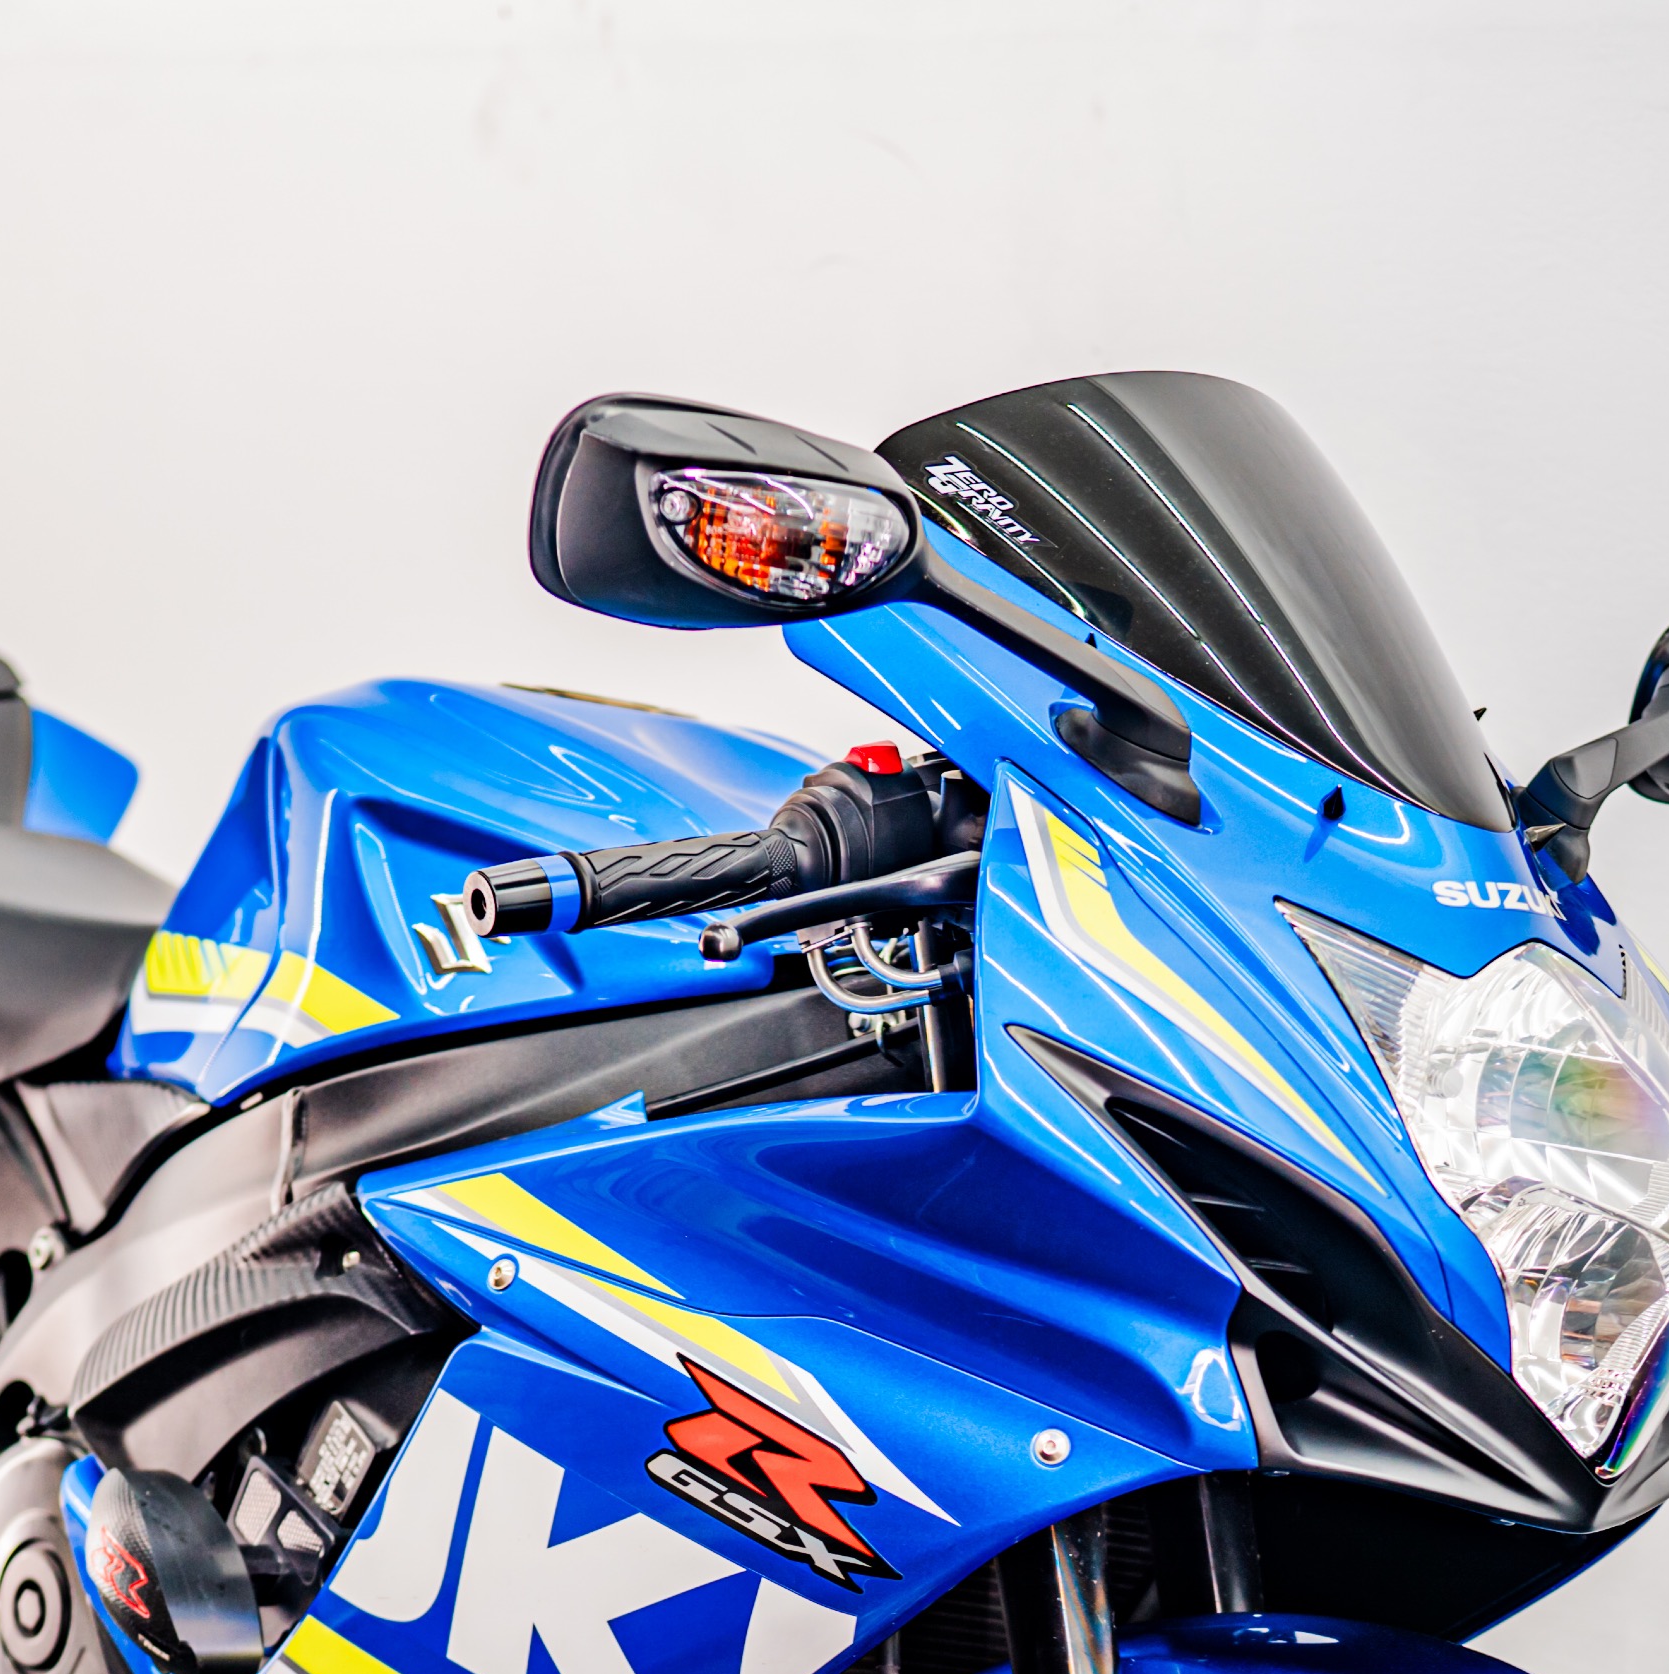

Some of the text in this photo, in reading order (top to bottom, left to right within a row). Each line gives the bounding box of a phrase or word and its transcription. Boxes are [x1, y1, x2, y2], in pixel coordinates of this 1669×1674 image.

[925, 456, 1014, 511] ZERO
[928, 477, 1040, 545] GRAVITY
[646, 1453, 873, 1581] GSX
